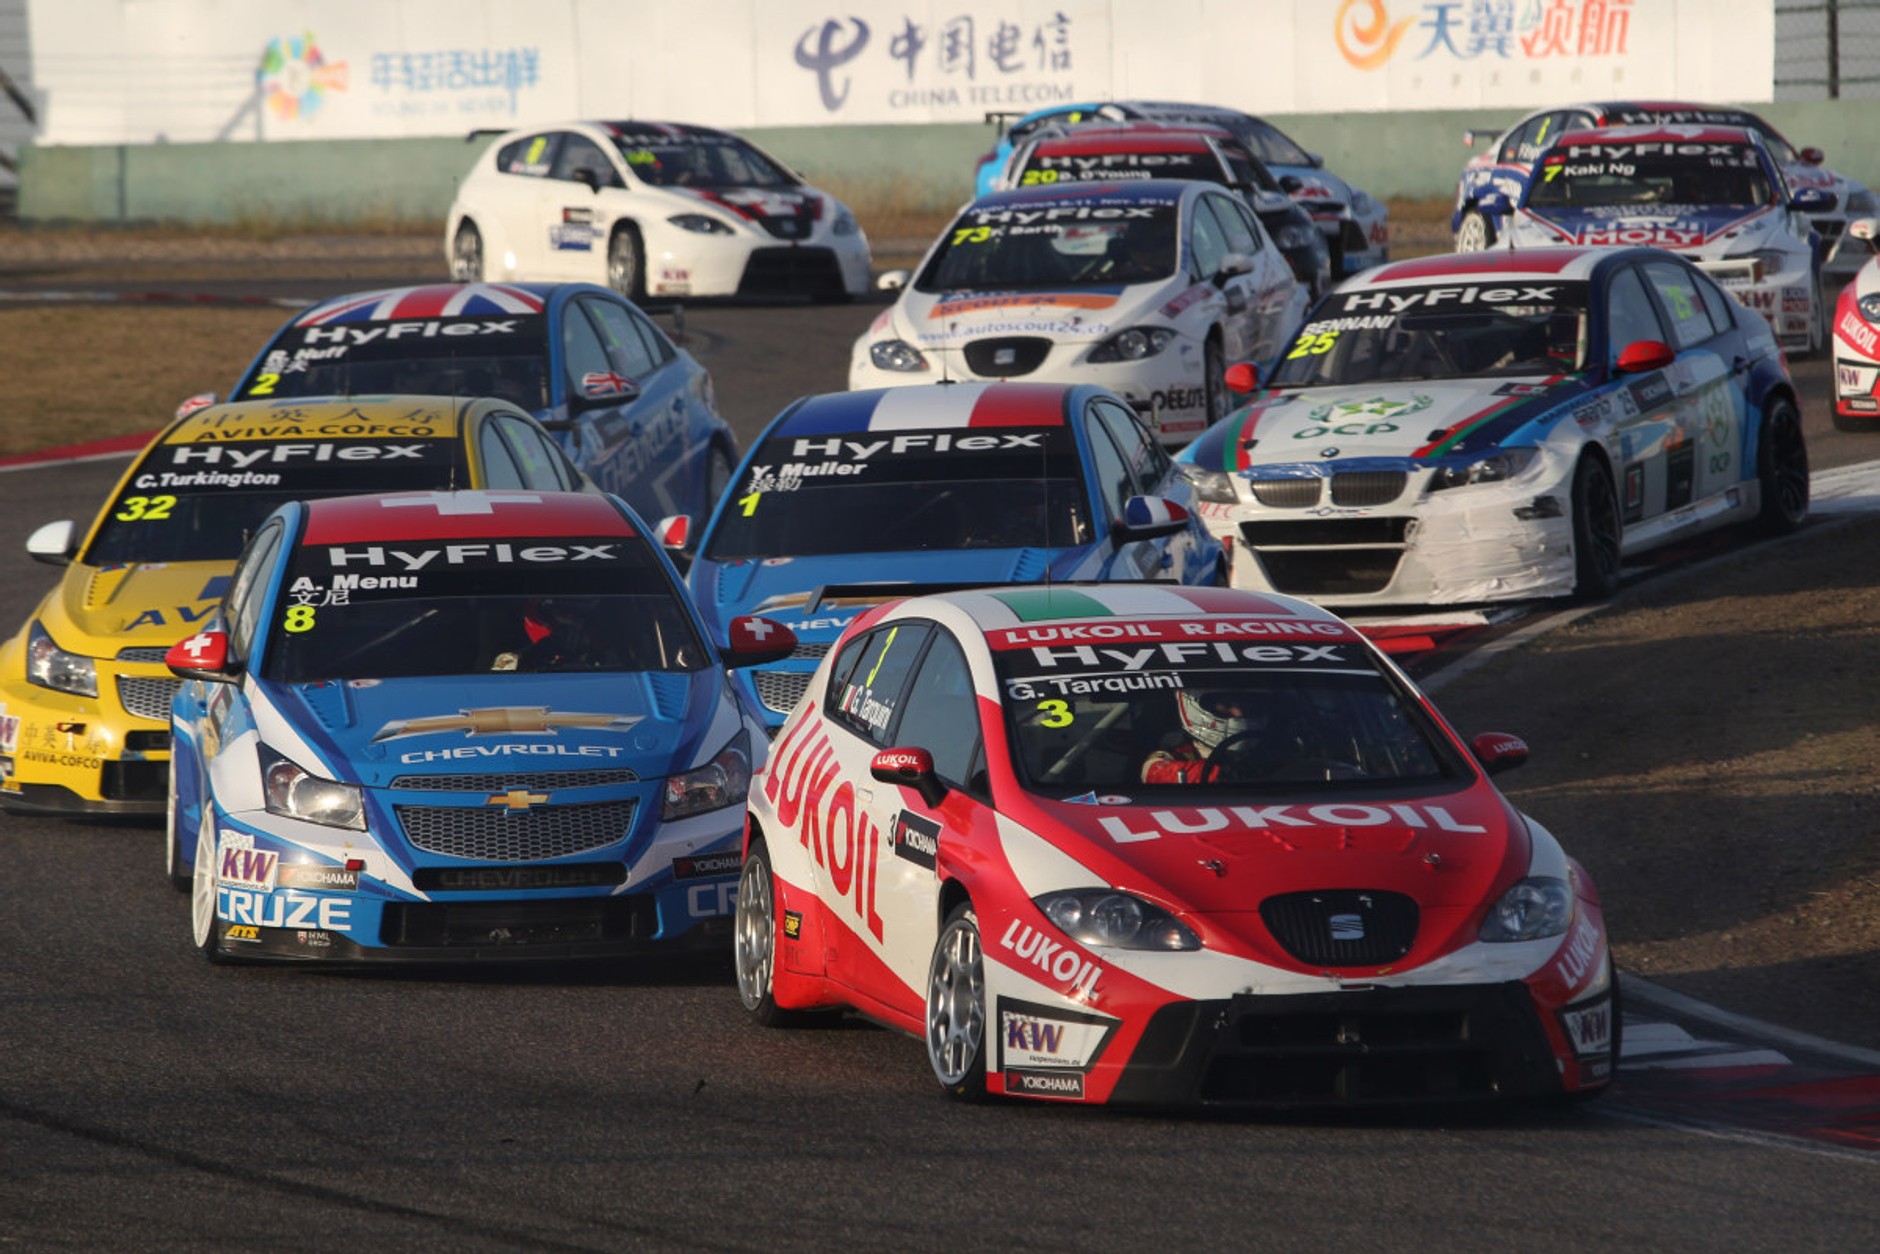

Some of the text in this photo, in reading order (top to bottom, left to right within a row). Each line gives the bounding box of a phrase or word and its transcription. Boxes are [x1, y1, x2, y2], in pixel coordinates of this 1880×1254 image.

[889, 11, 1074, 82] 中国电信
[889, 83, 1074, 109] CHINA TELECOM
[1041, 154, 1192, 168] HyFlex
[1568, 143, 1733, 159] HyFlex
[1022, 169, 1058, 186] 20
[1544, 164, 1563, 182] 7
[1564, 165, 1605, 177] Kaki
[1608, 163, 1636, 176] Ng
[976, 206, 1154, 224] HyFlex
[952, 226, 992, 245] 73
[1583, 230, 1699, 246] MOLY
[1343, 285, 1556, 313] HyFlex
[303, 320, 520, 346] HyFlex
[1300, 315, 1396, 337] BENNANI
[1840, 311, 1878, 355] LUKOIL
[1286, 330, 1341, 360] 25
[248, 373, 281, 396] 2
[1840, 368, 1860, 386] KW
[194, 424, 436, 442] AVIVA-COFCO
[172, 443, 428, 469] HyFlex
[792, 433, 1043, 460] HyFlex
[779, 461, 868, 478] Muller
[116, 495, 177, 522] 32
[738, 492, 762, 517] 1
[328, 543, 621, 571] HyFlex
[289, 573, 419, 593] A. Menu
[288, 589, 351, 608] 文尼
[283, 605, 316, 633] 8
[1007, 618, 1346, 645] LUKOIL RACING
[1030, 642, 1348, 670] HyFlex
[1008, 672, 1185, 701] G. Tarquini
[1036, 699, 1075, 729] 3
[24, 750, 100, 769] AVIVA-COFCO
[401, 744, 624, 765] CHEVROLET
[876, 753, 920, 766] LUKOIL
[765, 700, 884, 946] LUKOIL
[886, 813, 897, 848] 3
[1096, 803, 1488, 844] LUKOIL
[905, 826, 937, 857] YOKOHAMA
[222, 848, 275, 884] KW
[216, 886, 353, 931] CRUZE
[1000, 918, 1104, 1002] LUKOIL
[1006, 1017, 1066, 1055] KW
[1022, 1075, 1081, 1092] YOKOHAMA
